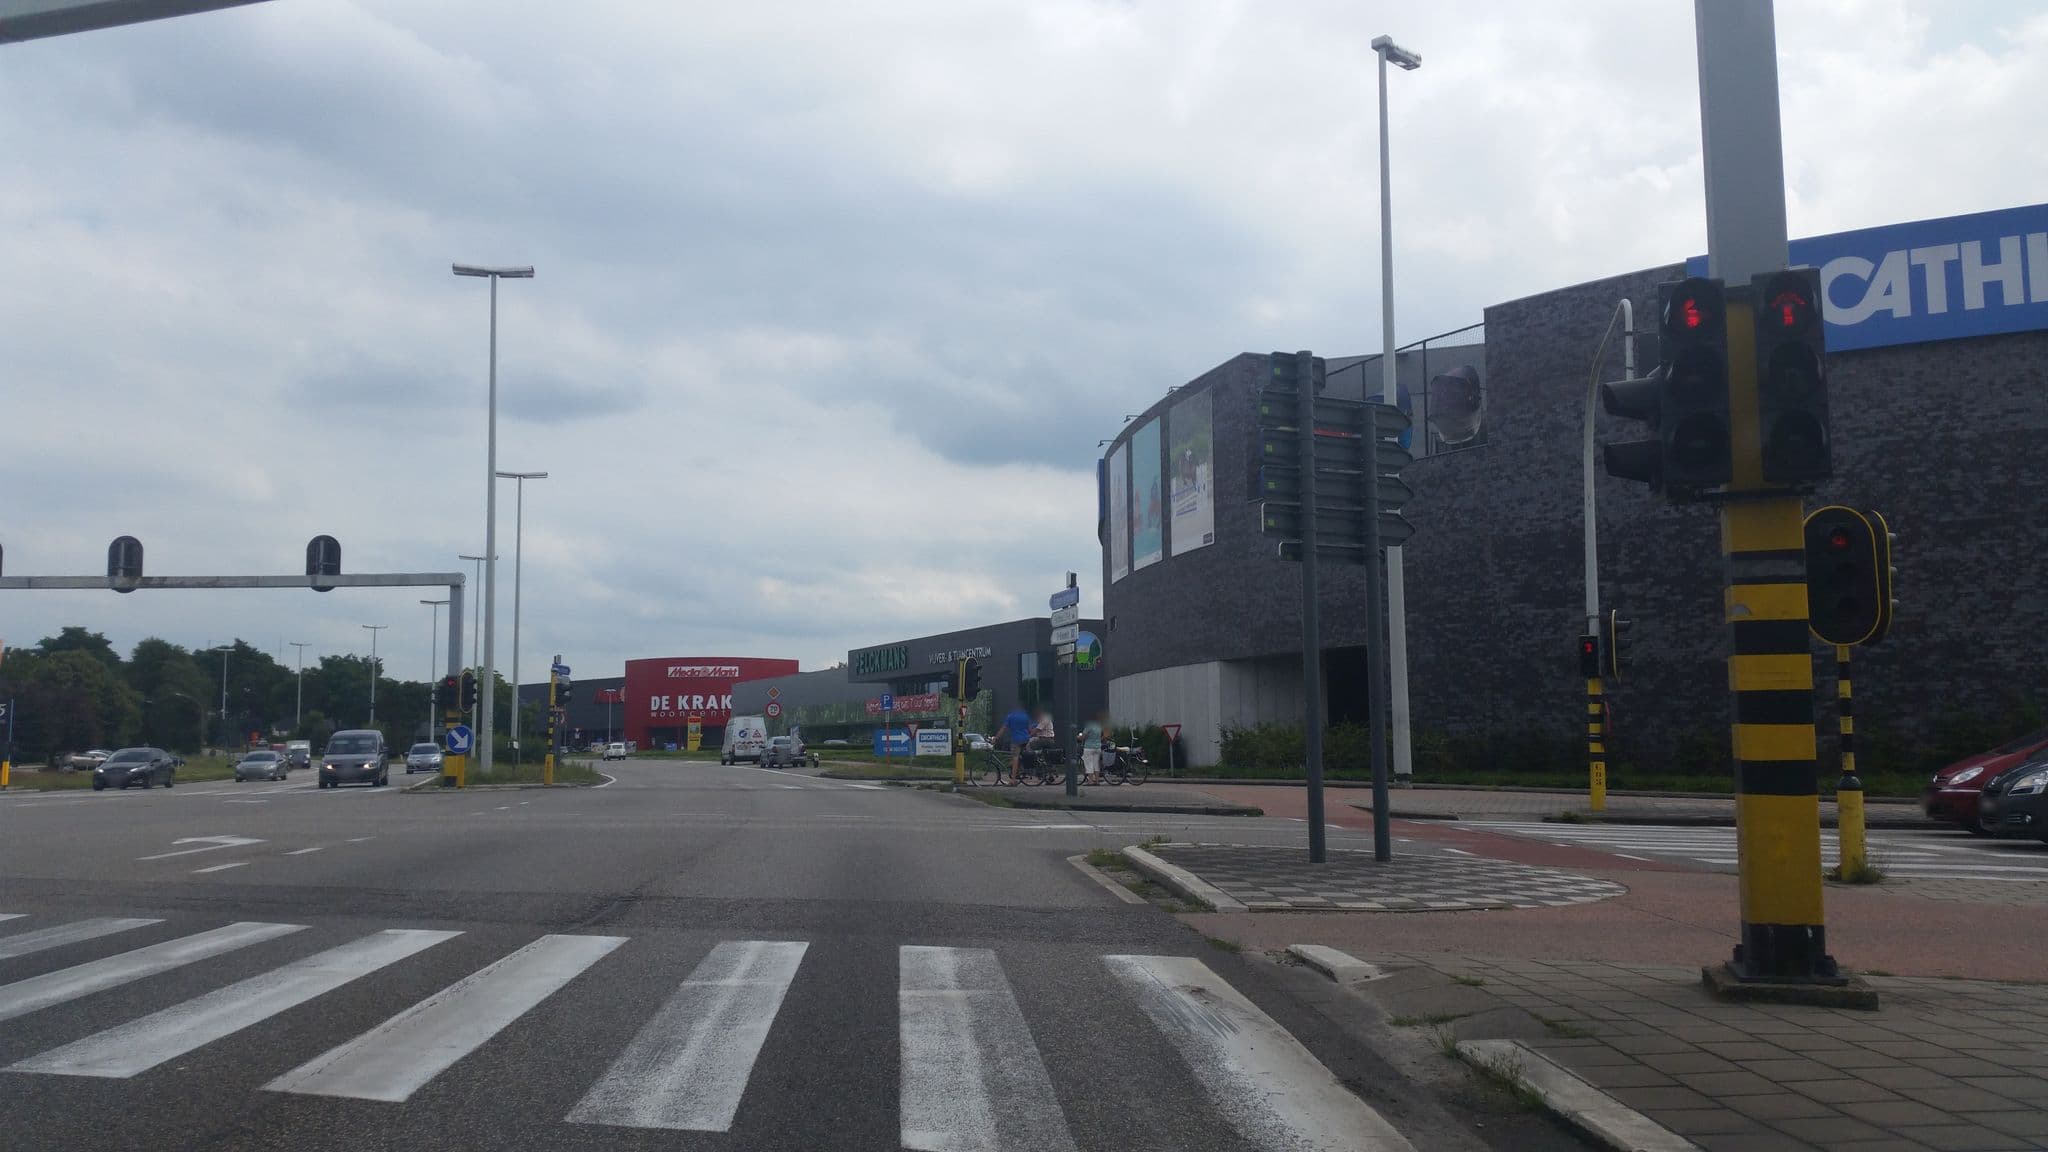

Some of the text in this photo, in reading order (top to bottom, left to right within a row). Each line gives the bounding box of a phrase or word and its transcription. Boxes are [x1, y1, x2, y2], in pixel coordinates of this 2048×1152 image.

[1821, 231, 2048, 326] CATH
[651, 694, 732, 711] DE KRAK
